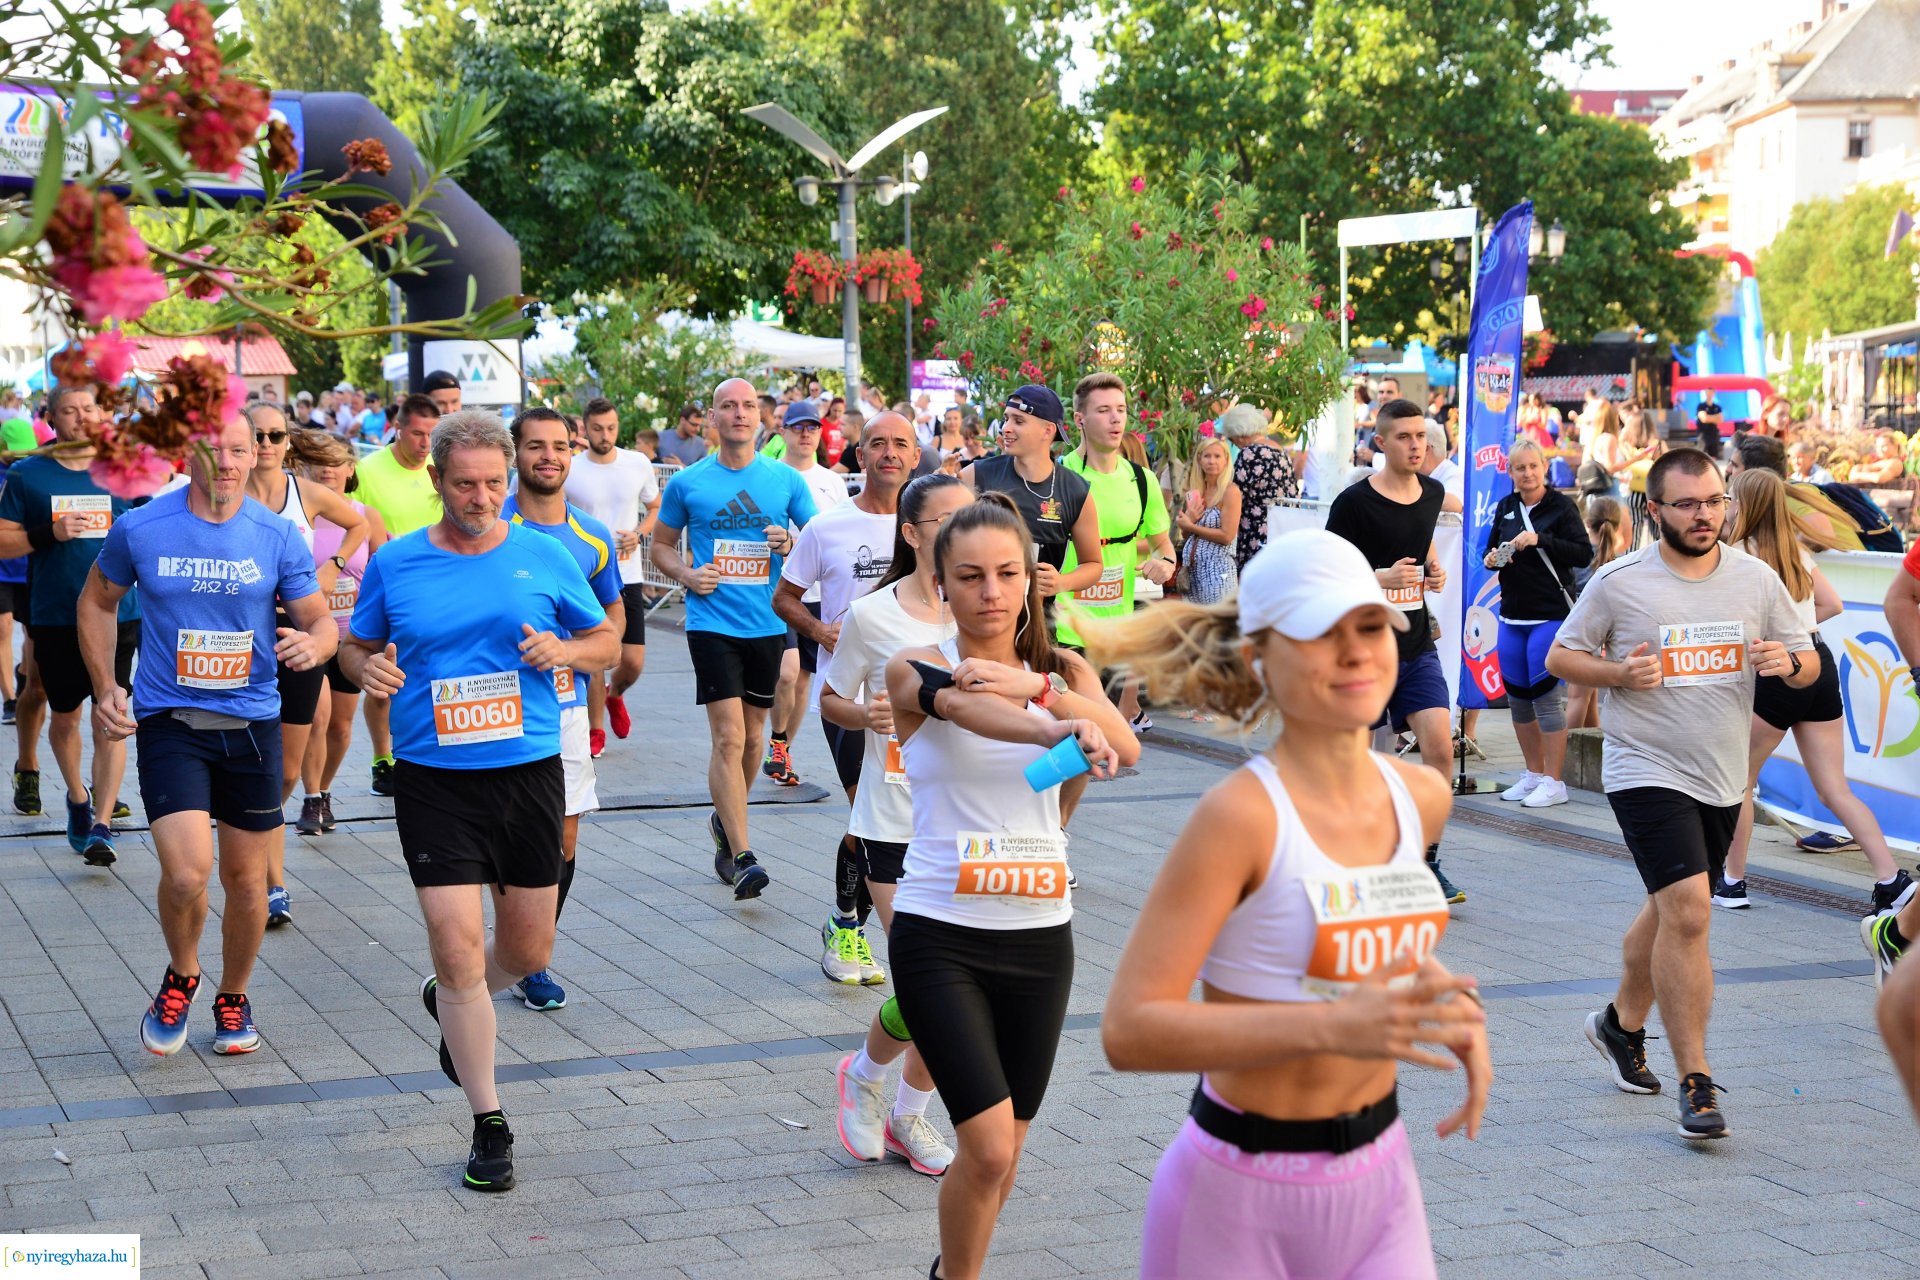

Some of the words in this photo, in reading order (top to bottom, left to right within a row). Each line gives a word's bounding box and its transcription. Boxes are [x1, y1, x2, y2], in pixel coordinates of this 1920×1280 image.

[710, 514, 771, 530] adidas
[718, 558, 768, 575] 10097
[183, 655, 247, 676] 10072
[1668, 648, 1738, 673] 10064
[441, 700, 517, 731] 10060
[973, 867, 1056, 895] 10113
[1332, 920, 1438, 976] 10140
